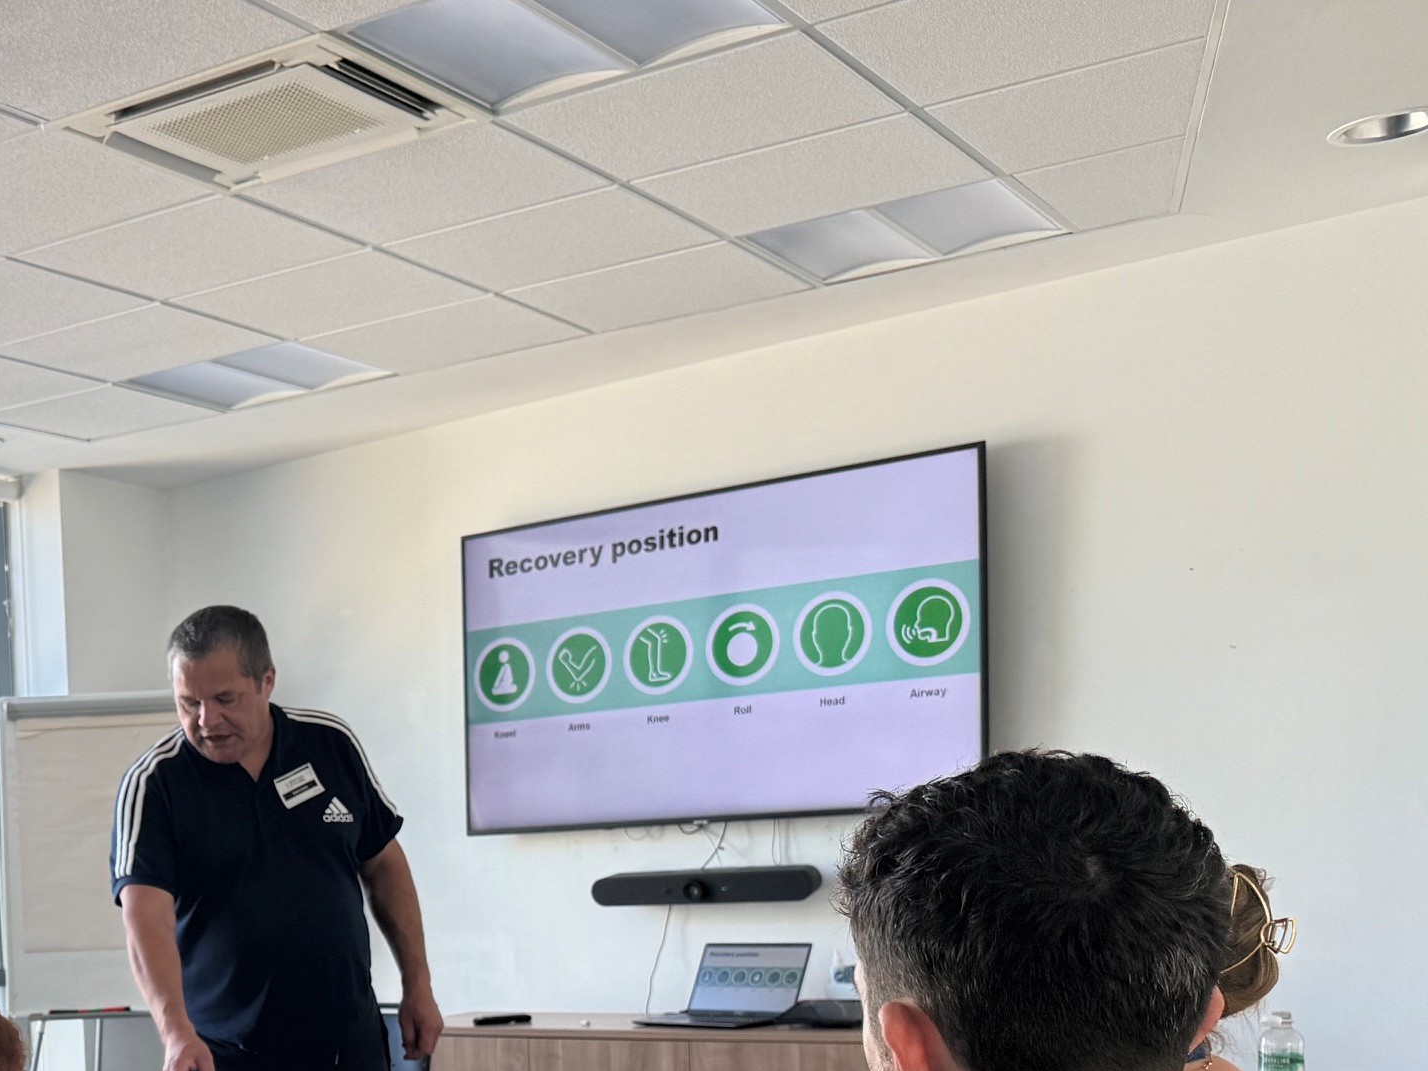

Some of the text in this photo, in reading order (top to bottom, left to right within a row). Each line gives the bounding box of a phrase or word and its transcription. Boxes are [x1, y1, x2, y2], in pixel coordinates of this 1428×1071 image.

[488, 525, 719, 579] Recovery position
[910, 686, 947, 698] Airway
[819, 696, 846, 707] Head
[733, 705, 752, 715] Roll
[647, 714, 669, 724] Knee
[568, 722, 590, 732] Arms
